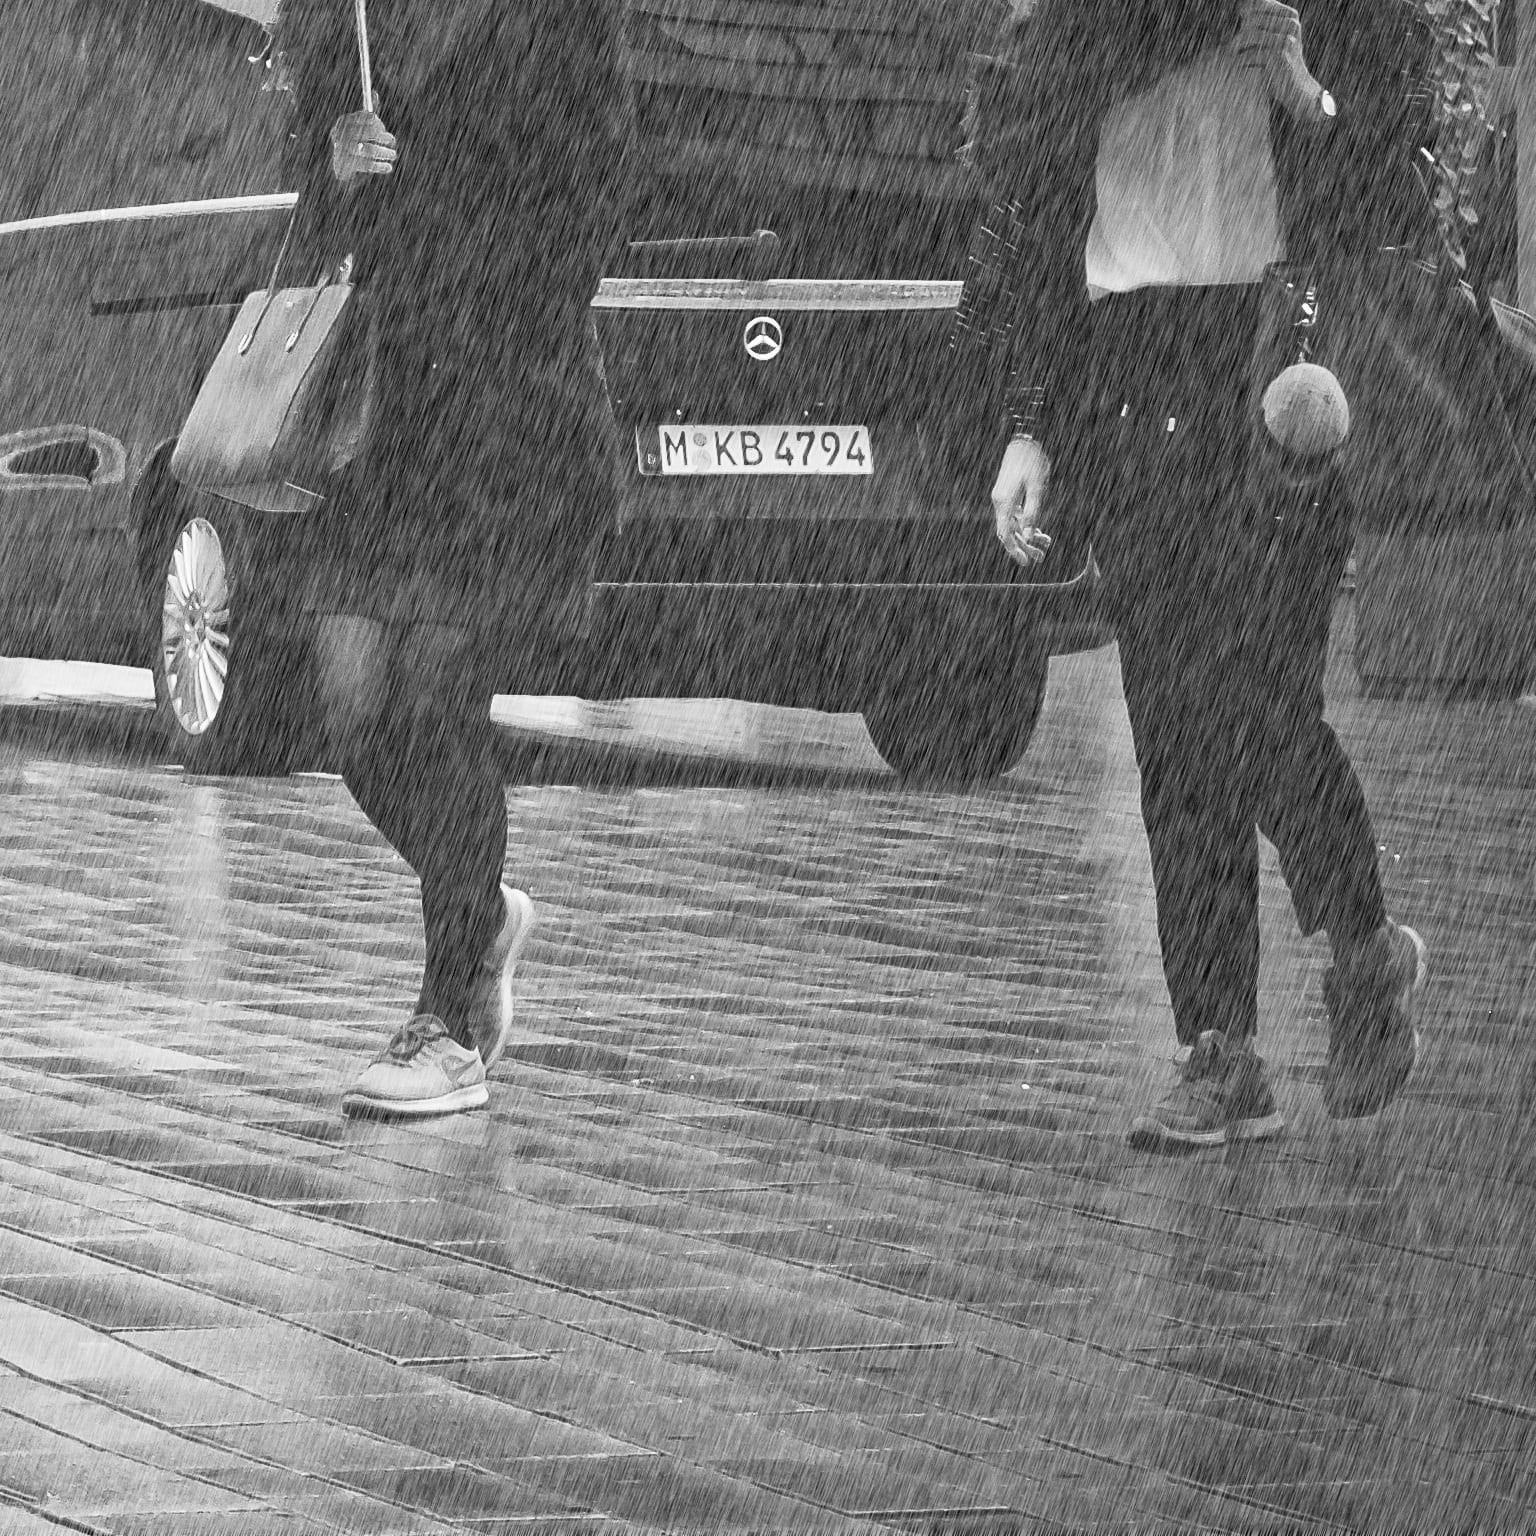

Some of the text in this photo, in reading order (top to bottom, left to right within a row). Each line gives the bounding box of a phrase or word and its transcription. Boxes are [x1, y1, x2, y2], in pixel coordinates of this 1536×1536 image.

[664, 430, 866, 466] M KB 4794
